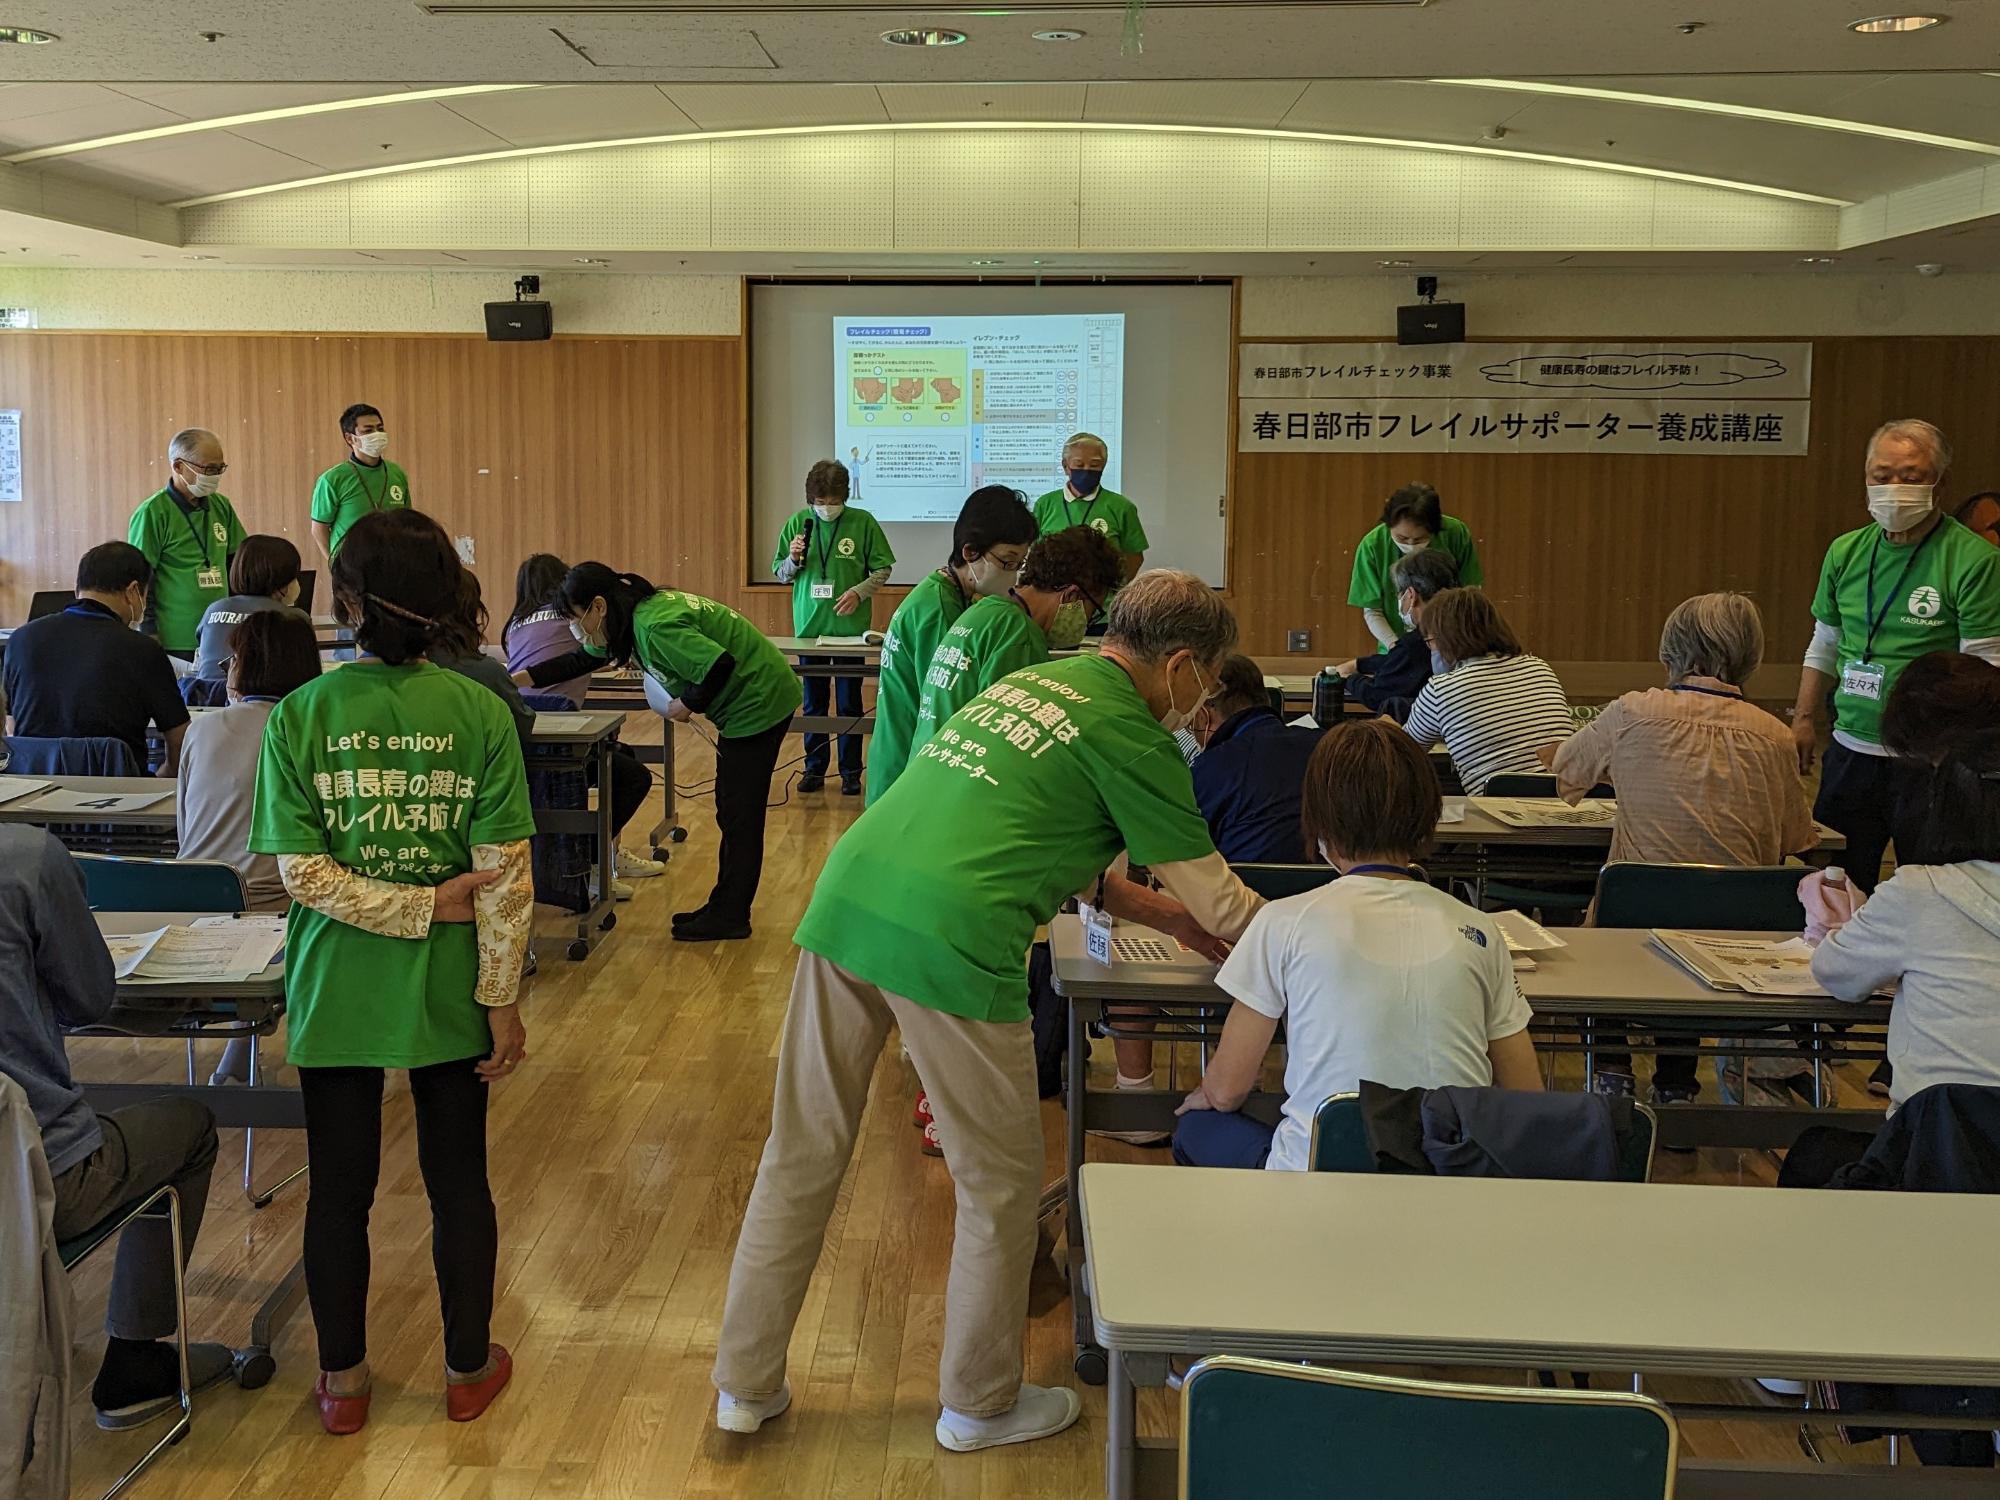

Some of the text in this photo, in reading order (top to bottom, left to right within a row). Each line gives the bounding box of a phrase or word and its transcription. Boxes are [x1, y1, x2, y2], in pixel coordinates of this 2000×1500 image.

[1254, 364, 1452, 379] 春日部市フレイルチェック事業
[1540, 364, 1700, 376] 健康長寿の鍵はフレイル予防！
[1252, 410, 1784, 443] 春日部市フレイルサポーター養成講座
[1037, 678, 1092, 703] enjoy!
[1846, 676, 1879, 693] 佐々木
[326, 730, 453, 753] Let's enjoy!
[941, 728, 988, 757] We are
[312, 768, 476, 800] 健康長寿の鍵は
[74, 797, 125, 810] 4
[360, 845, 430, 861] We are
[1089, 930, 1107, 959] 佐藤
